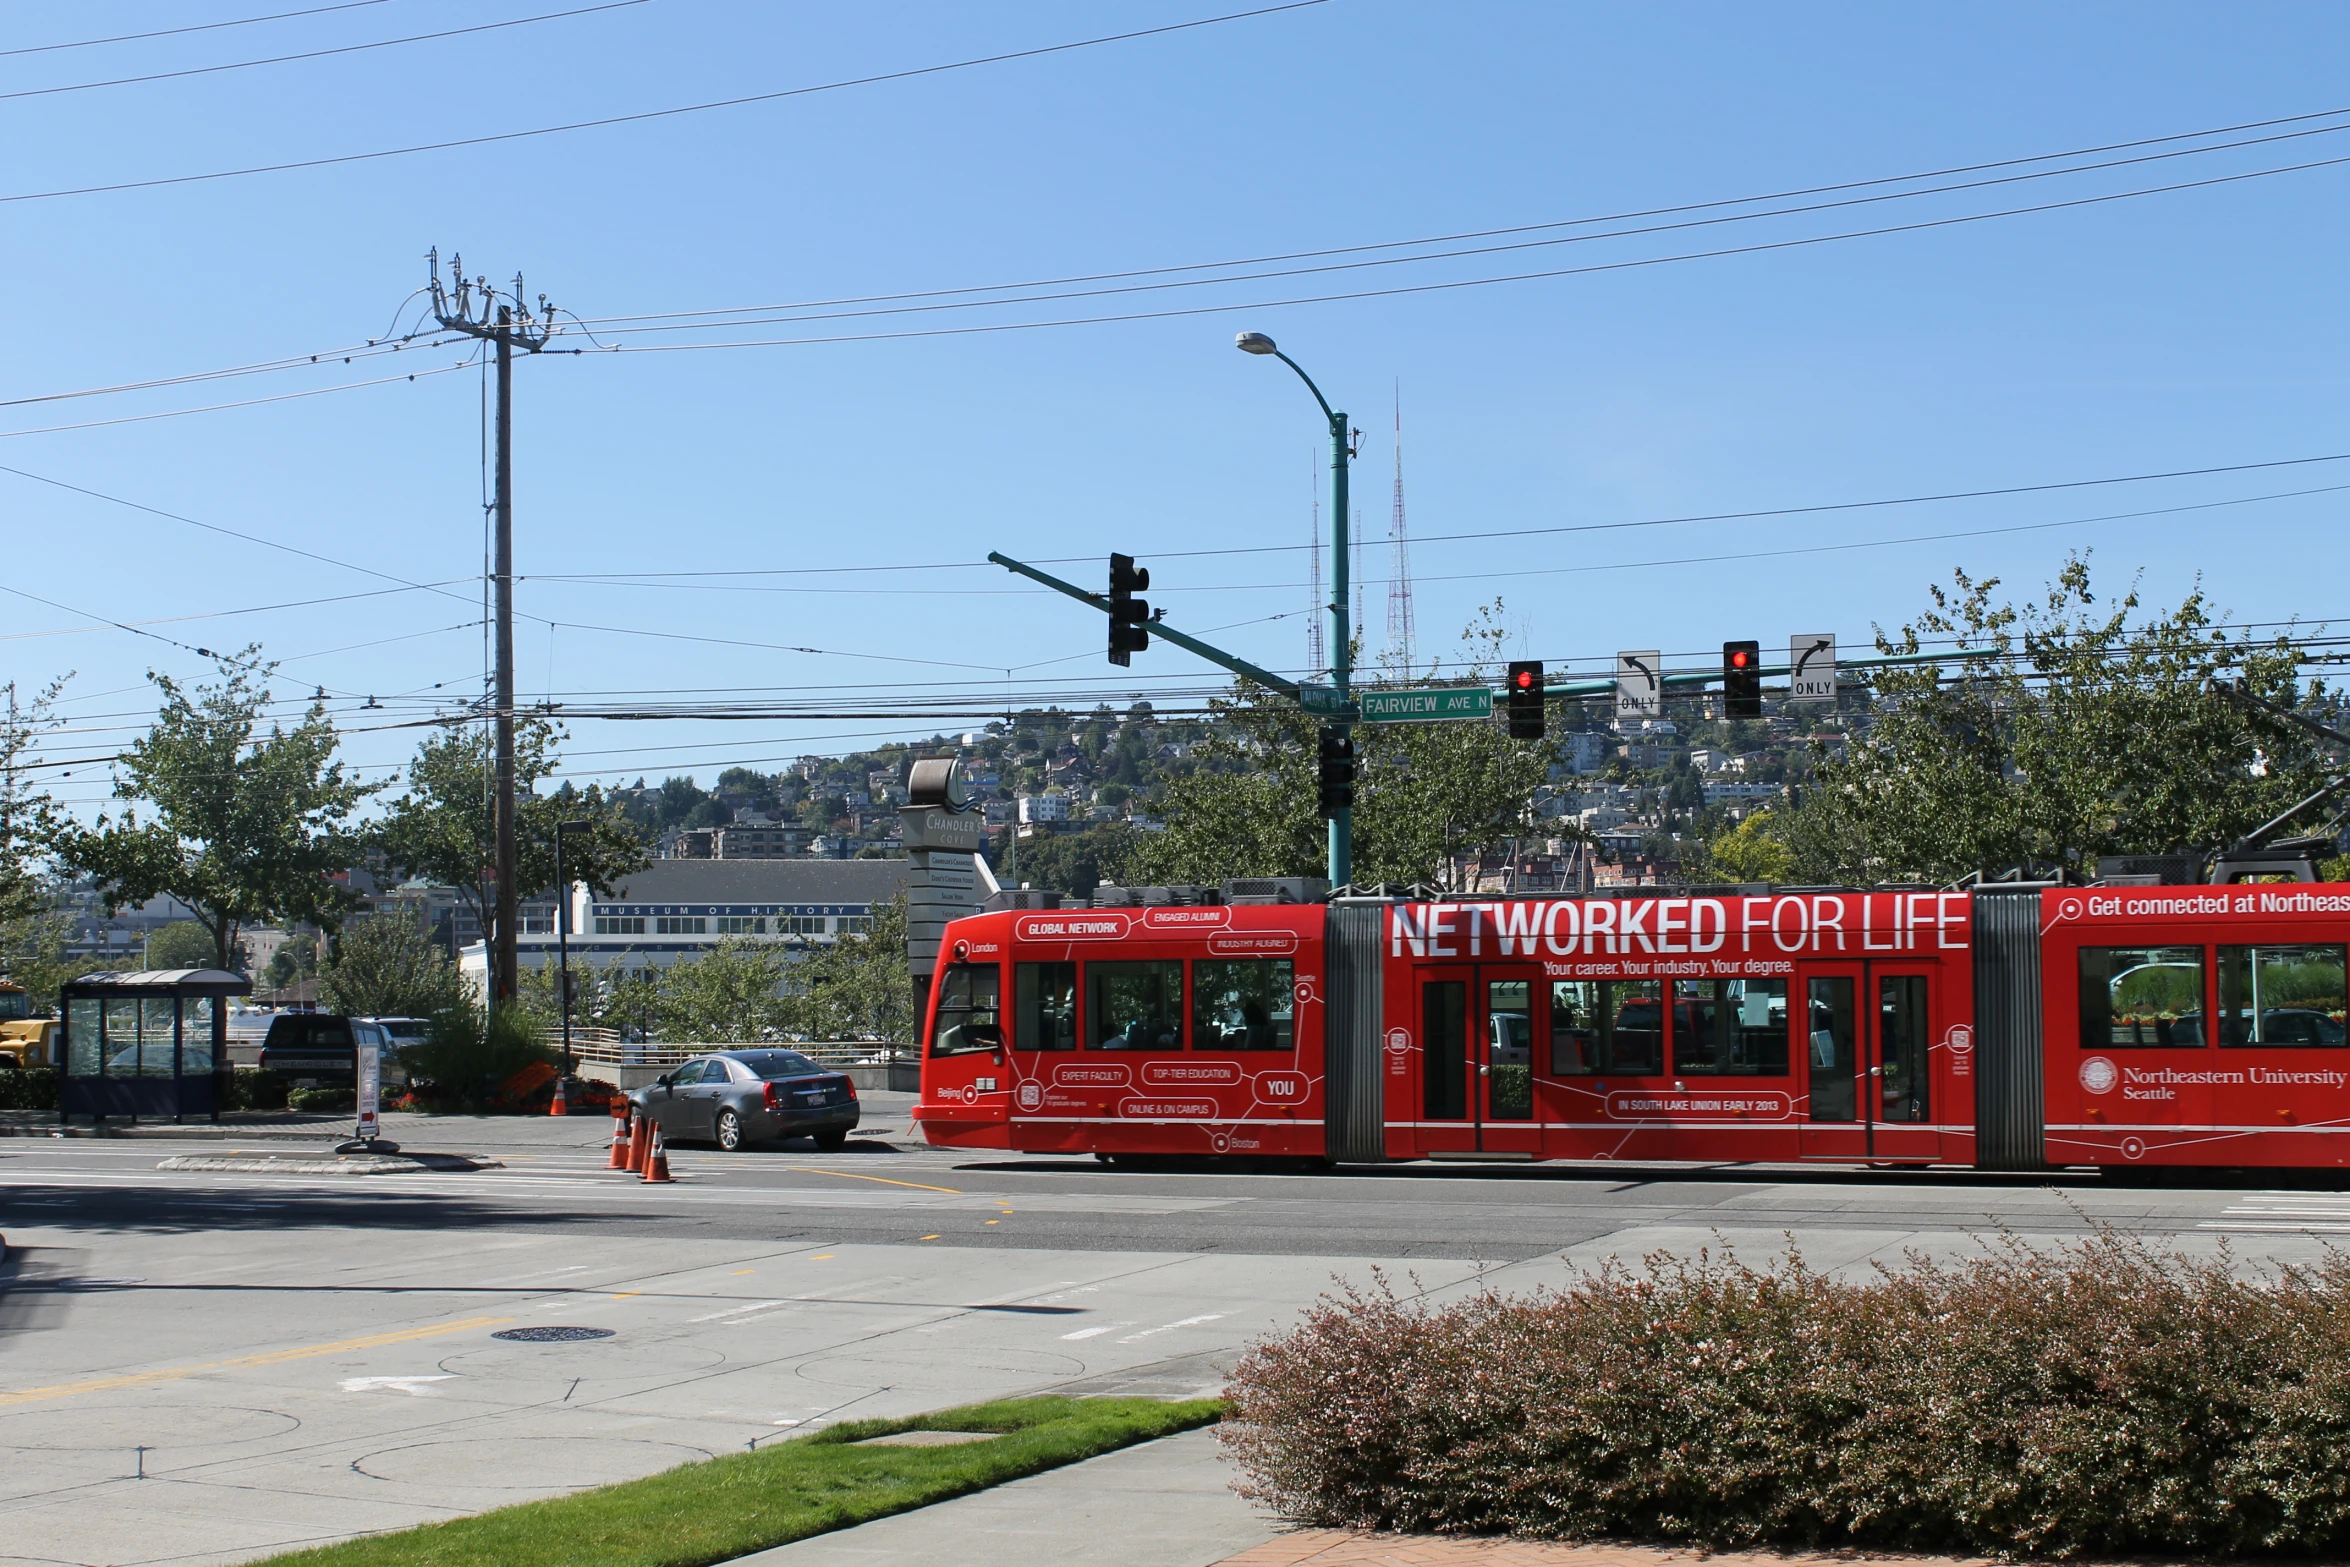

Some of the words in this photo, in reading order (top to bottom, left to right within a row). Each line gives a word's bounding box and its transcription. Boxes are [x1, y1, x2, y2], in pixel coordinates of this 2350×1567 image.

[1796, 682, 1831, 695] ONLY
[1304, 691, 1327, 708] ALOHA
[1331, 697, 1337, 709] ST
[1366, 697, 1437, 713] FAIRVIEW
[1447, 697, 1470, 709] AVE
[1478, 696, 1487, 707] N
[1621, 697, 1655, 710] ONLY
[926, 814, 981, 833] CHANDLER'S
[940, 834, 964, 844] COVE
[600, 907, 689, 915] MUSEUM
[709, 907, 731, 915] OF
[863, 907, 871, 915] &
[2088, 896, 2122, 916] Get
[2126, 894, 2229, 915] connected
[2234, 896, 2255, 913] at
[1154, 913, 1190, 922] ENGAGED
[1191, 912, 1220, 921] ALUMNI
[1028, 923, 1066, 935] GLOBAL
[1068, 922, 1118, 934] NETWORK
[1392, 899, 1726, 957] NETWORKED
[1742, 896, 1846, 952] FOR
[1863, 893, 1969, 950] LIFE
[971, 943, 998, 953] London
[1544, 961, 1572, 976] Your
[1575, 960, 1619, 975] career.
[1621, 960, 1651, 974] Your
[1653, 959, 1709, 976] industry.
[1711, 959, 1740, 973] Your
[1744, 959, 1794, 976] degree.
[1295, 974, 1316, 982] Seattle
[1062, 1071, 1089, 1080] EXPERT
[1090, 1071, 1123, 1080] FACULTY
[1153, 1069, 1187, 1078] TOP-TIER
[1188, 1069, 1231, 1078] EDUCATION
[2123, 1067, 2244, 1084] Northeastern
[2248, 1067, 2348, 1089] University
[937, 1087, 961, 1100] Beijing
[1267, 1080, 1294, 1096] YOU
[2123, 1086, 2176, 1100] Seattle
[1127, 1104, 1155, 1114] ONLINE
[1156, 1105, 1162, 1114] &
[1163, 1105, 1175, 1114] ON
[1176, 1105, 1209, 1114] CAMPUS
[1618, 1101, 1629, 1110] IN
[1631, 1101, 1662, 1110] SOUTH
[1664, 1101, 1689, 1110] LAKE
[1690, 1101, 1721, 1110] UNION
[1723, 1101, 1753, 1111] EARLY
[1755, 1101, 1779, 1110] 2013
[1231, 1138, 1260, 1149] Boston
